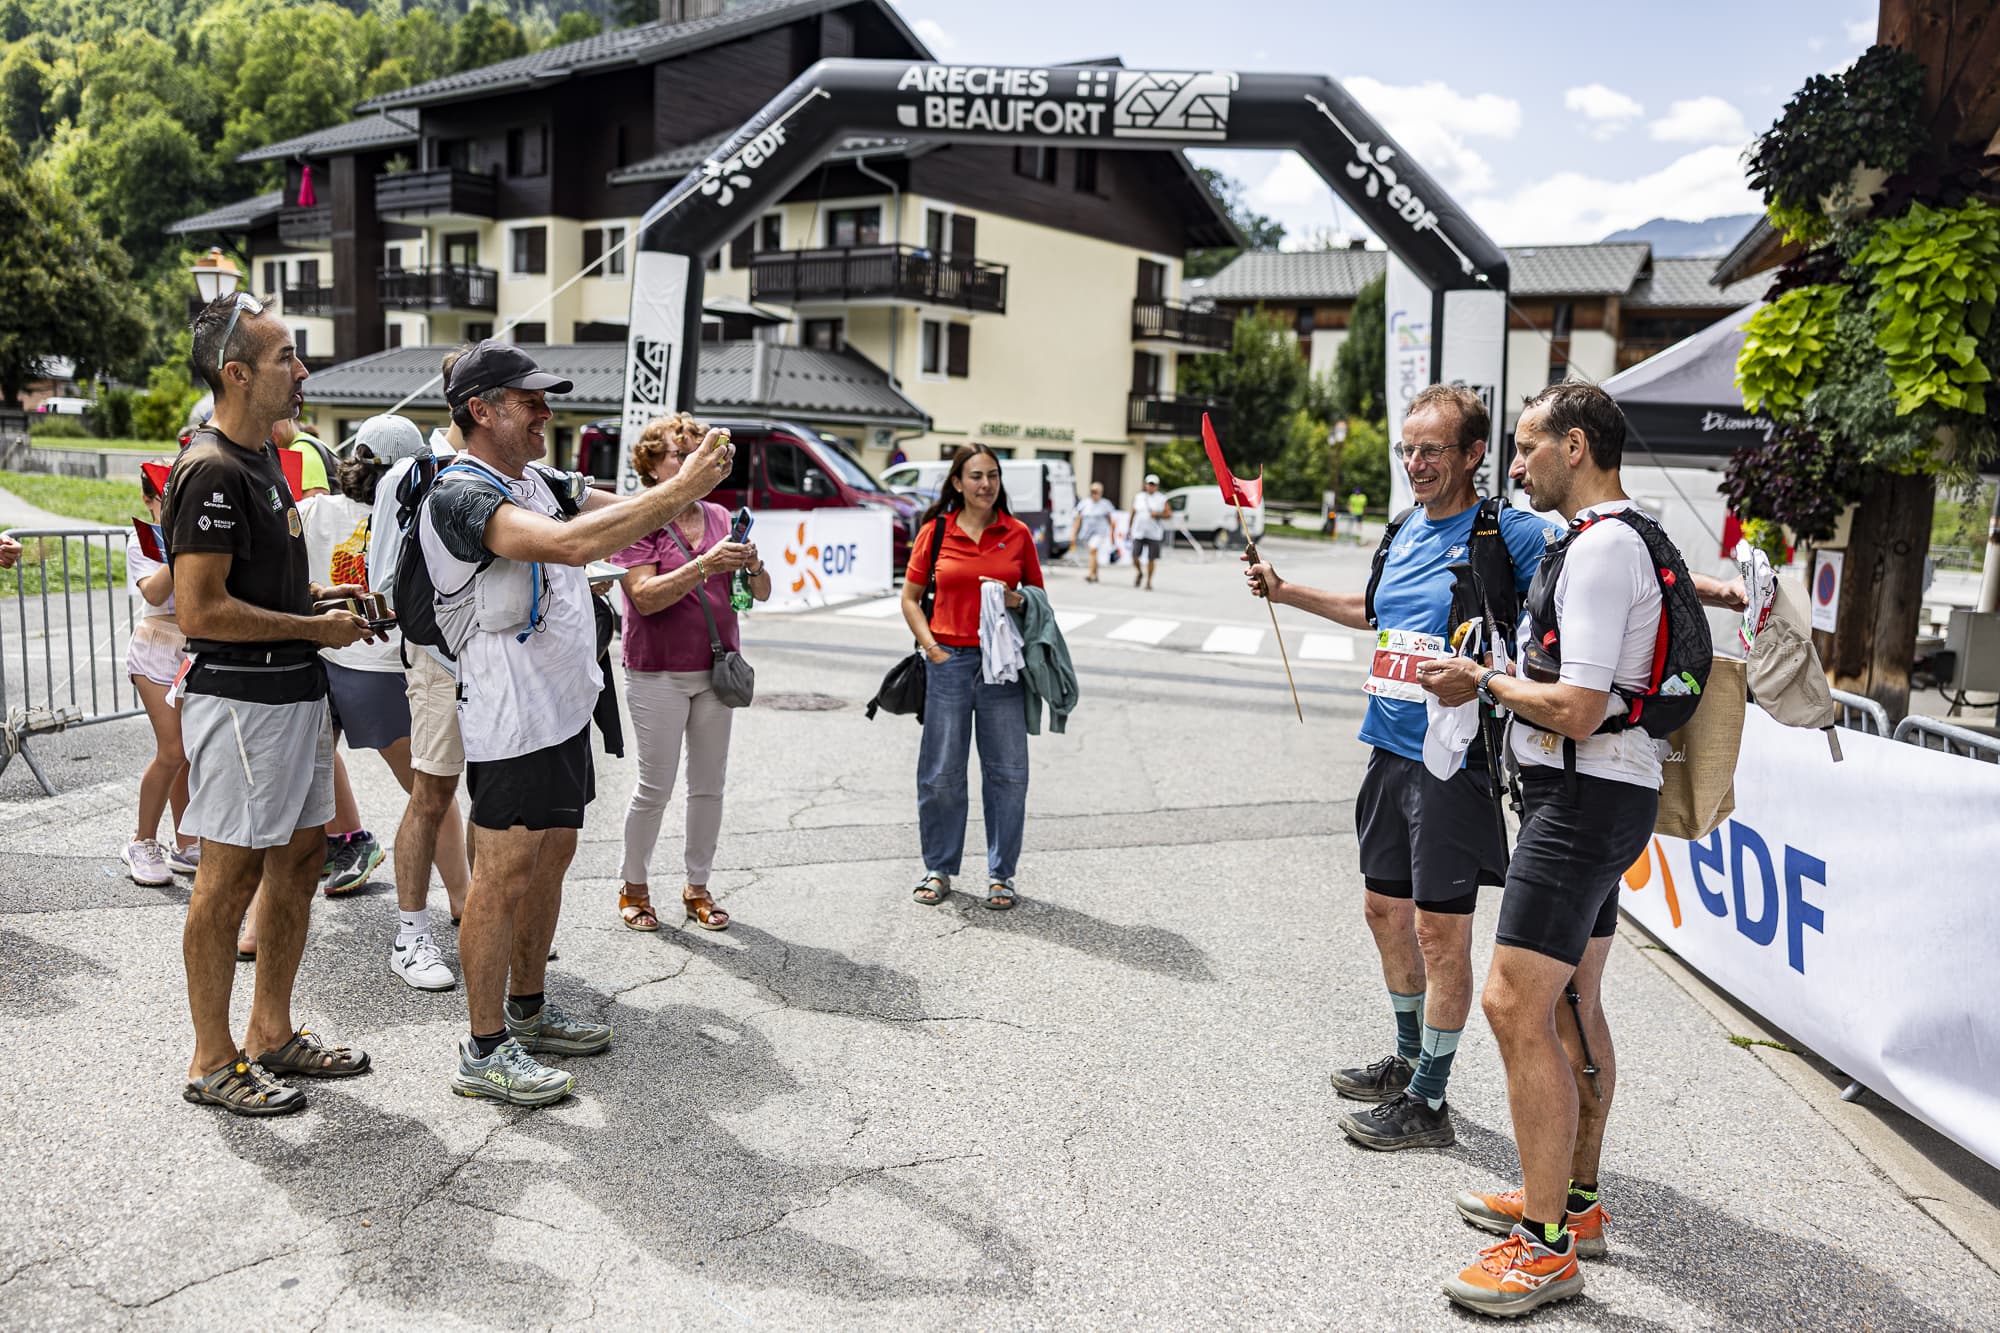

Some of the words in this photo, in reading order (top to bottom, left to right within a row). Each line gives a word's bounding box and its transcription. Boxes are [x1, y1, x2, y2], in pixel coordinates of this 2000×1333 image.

[897, 65, 1048, 96] ARECHES
[925, 96, 1105, 135] BEAUFORT
[1388, 654, 1409, 679] 71
